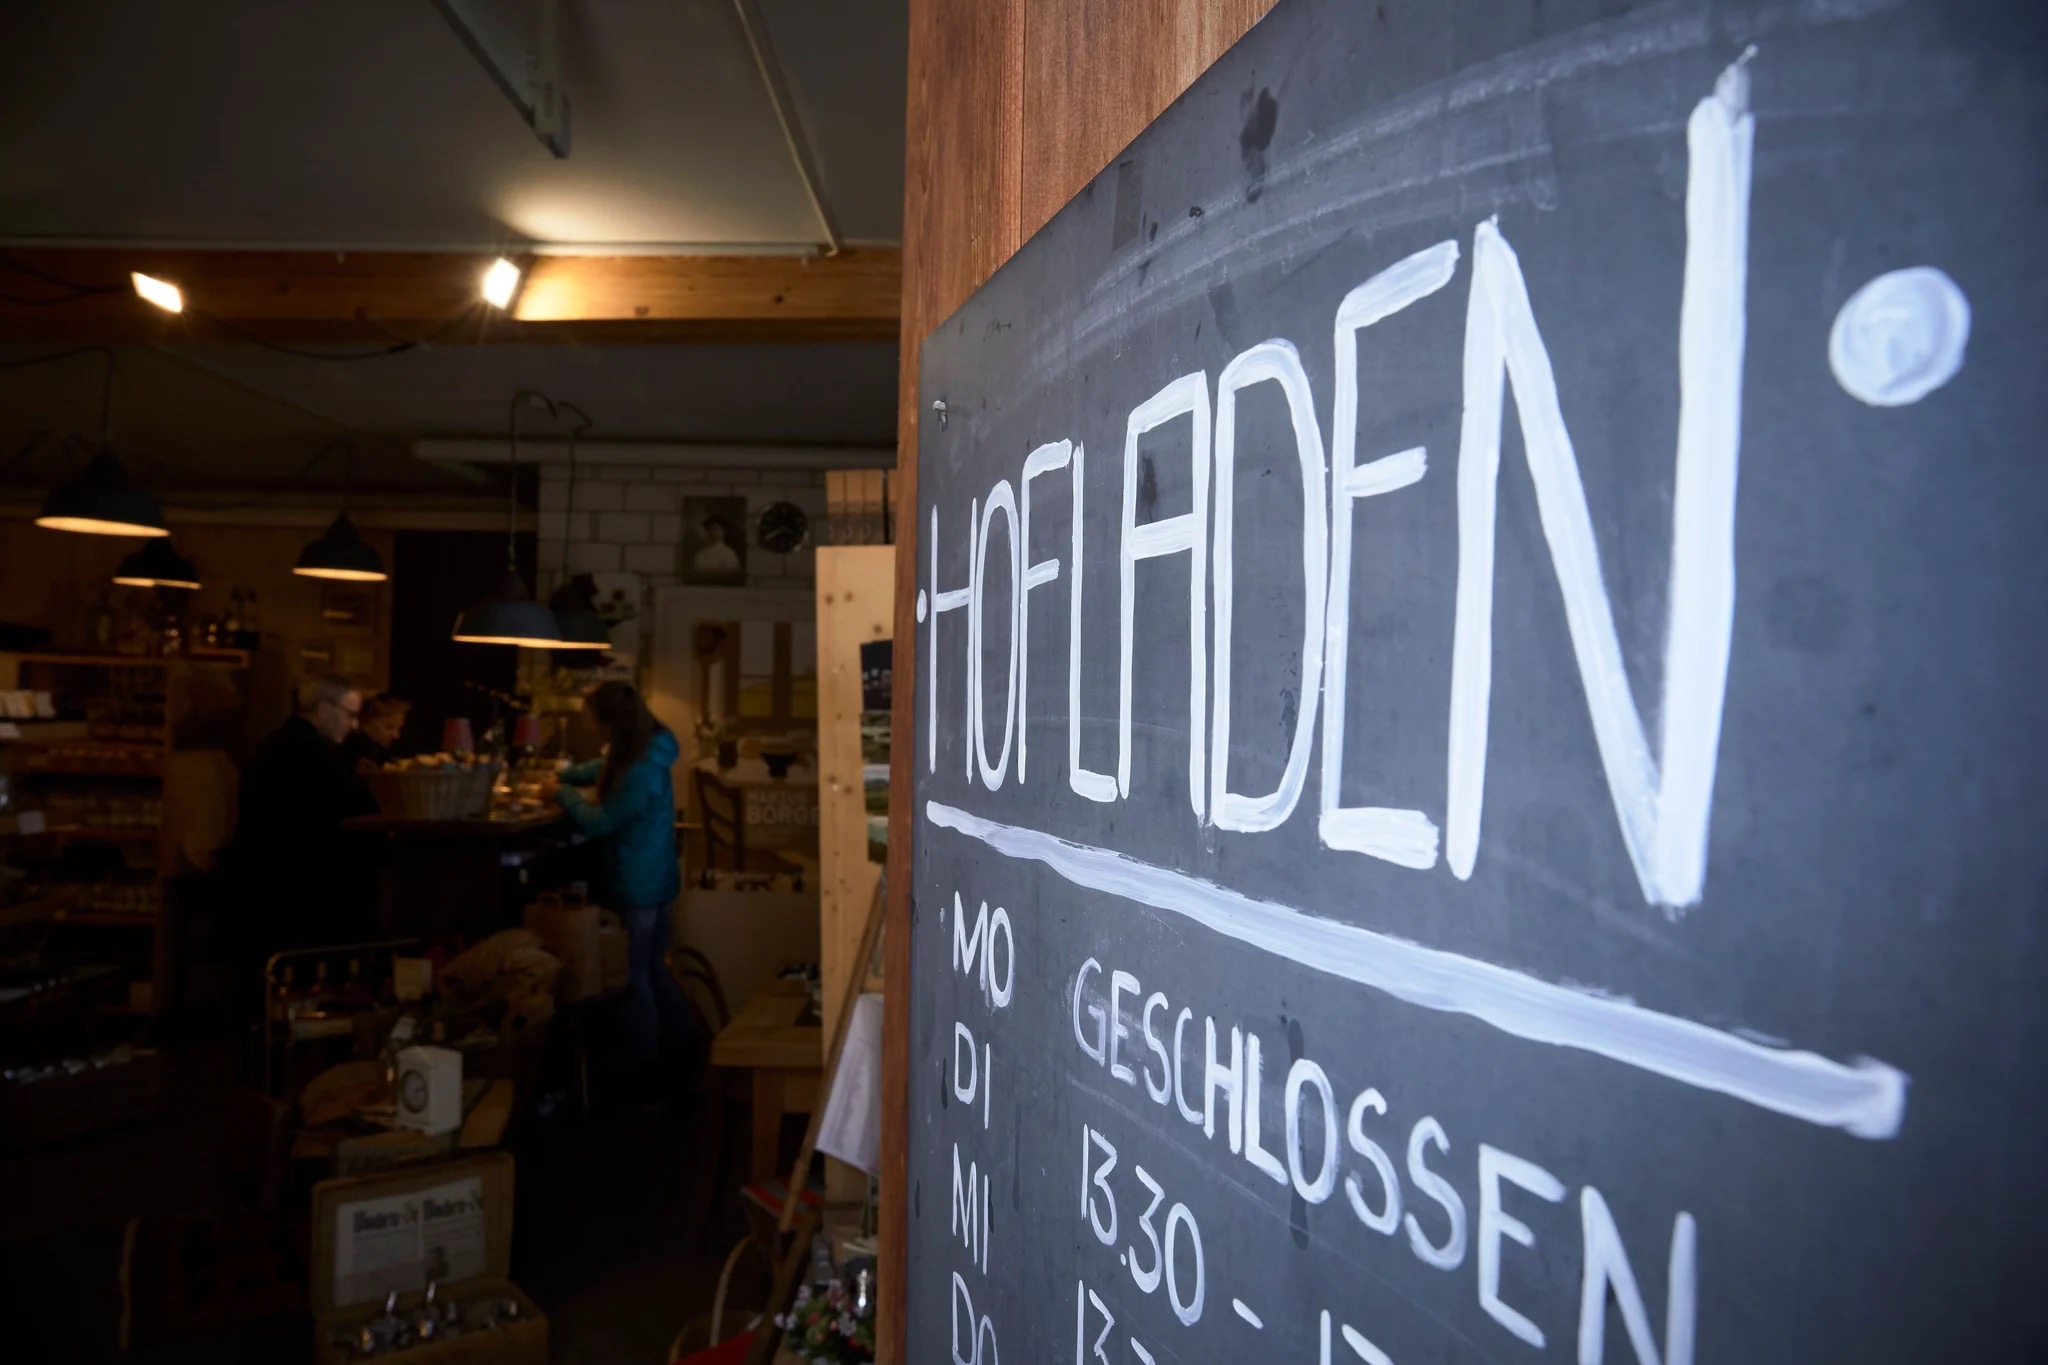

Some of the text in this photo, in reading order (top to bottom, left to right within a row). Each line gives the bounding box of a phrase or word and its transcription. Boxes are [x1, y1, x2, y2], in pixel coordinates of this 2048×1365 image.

[952, 1143, 989, 1276] MI
[953, 890, 1698, 1365] MO GESCHLOSSEN
[954, 1021, 990, 1130] DI
[1080, 1123, 1205, 1327] 13.30
